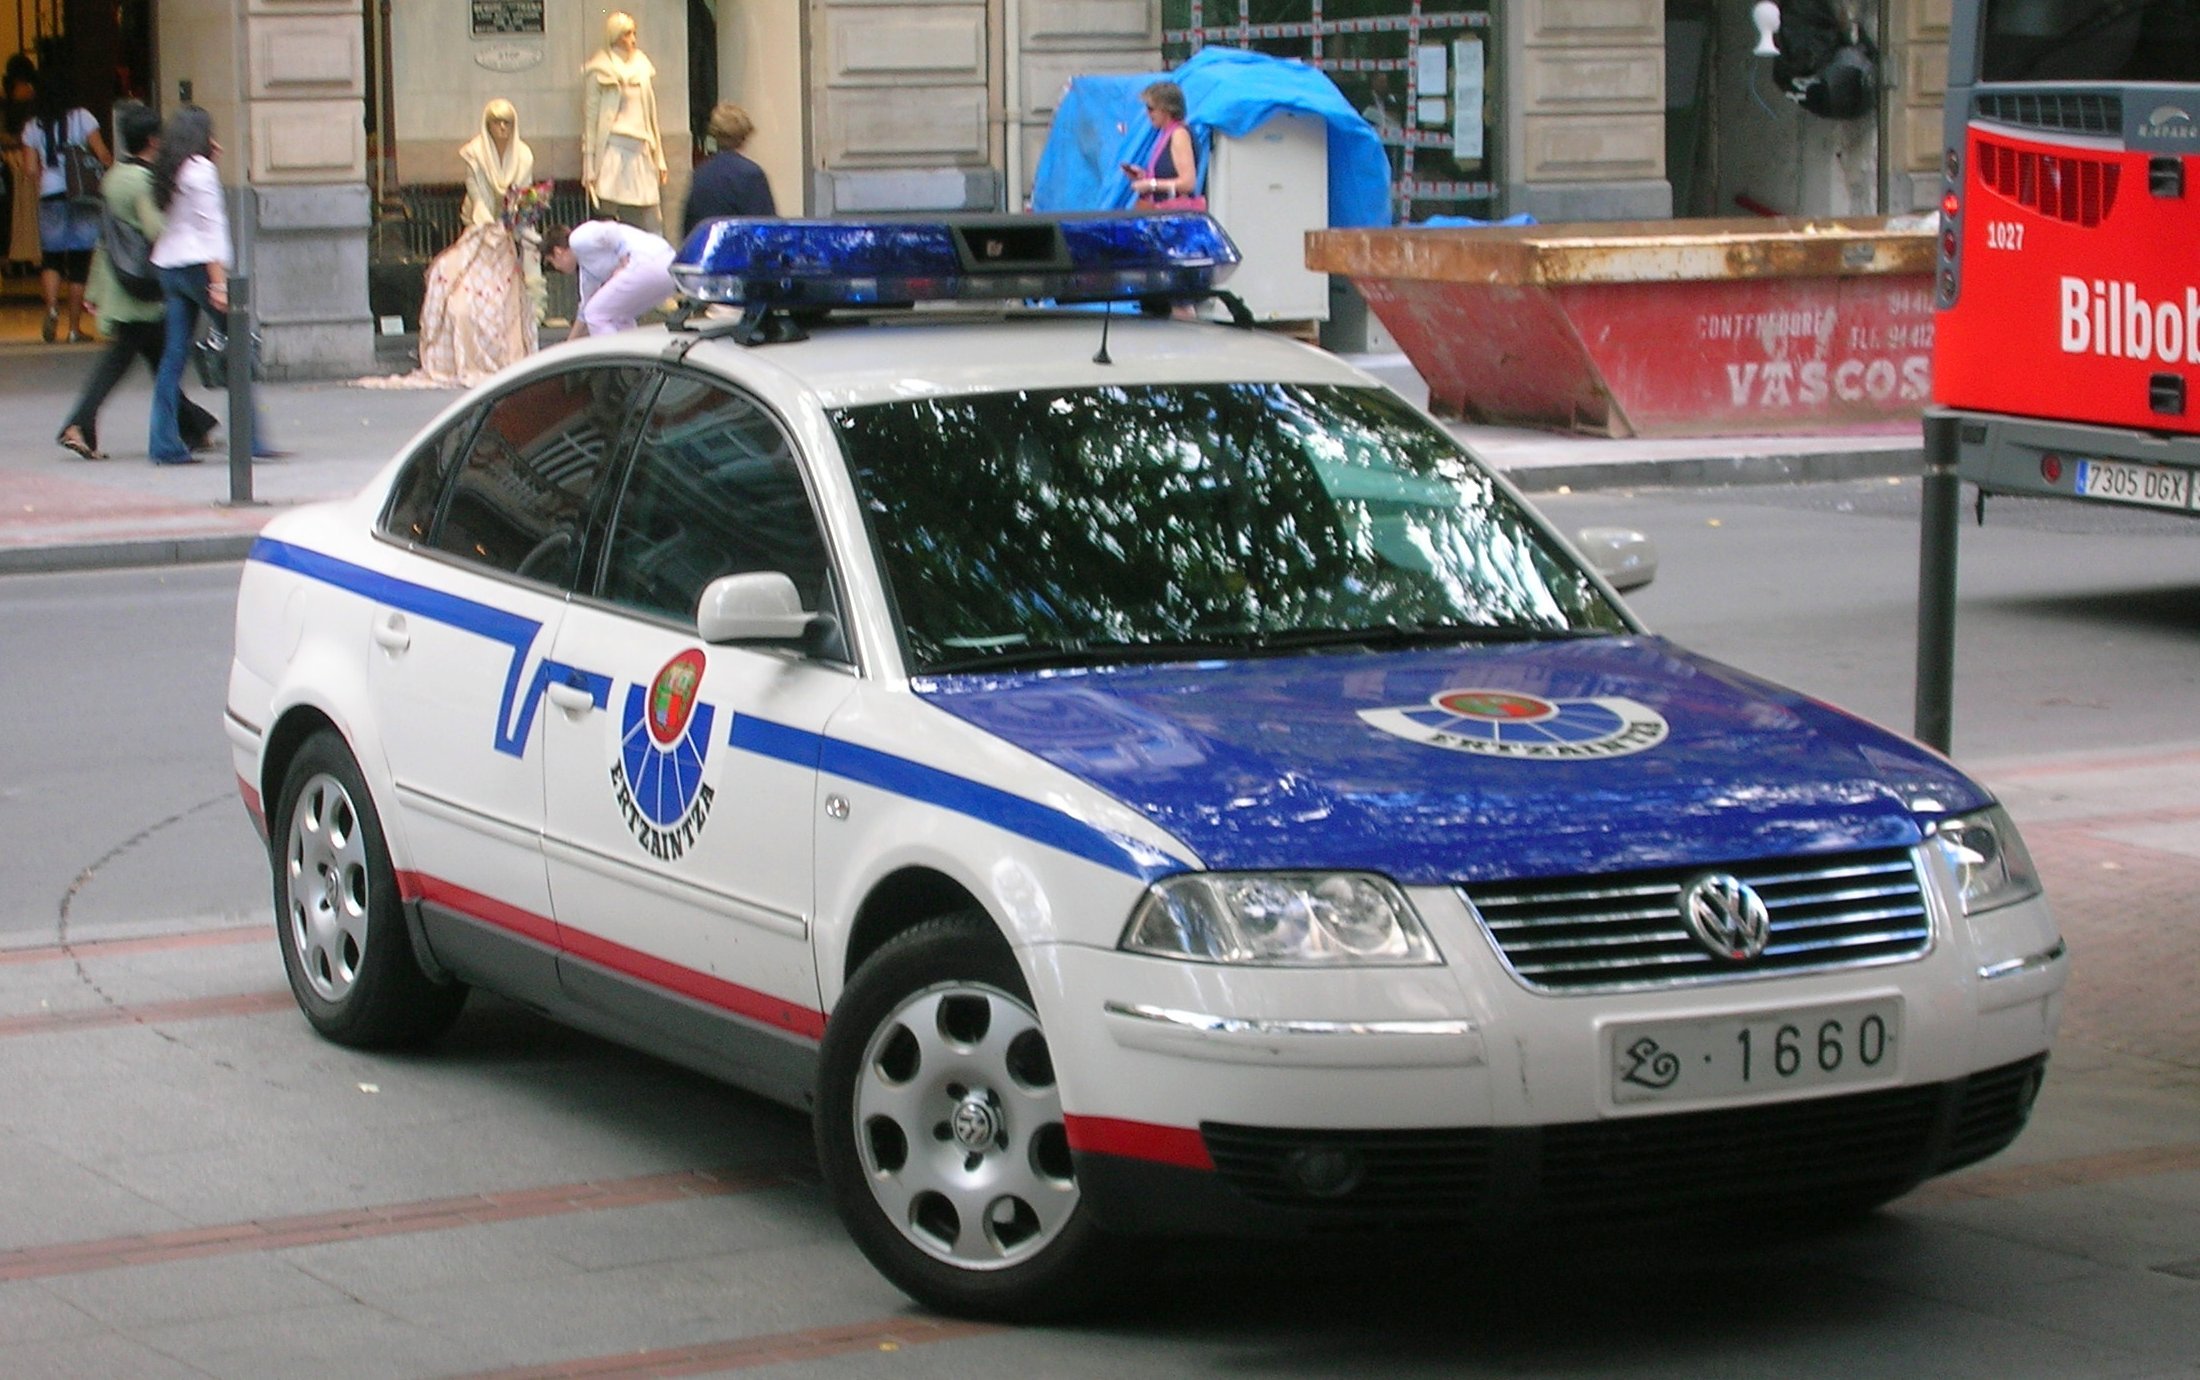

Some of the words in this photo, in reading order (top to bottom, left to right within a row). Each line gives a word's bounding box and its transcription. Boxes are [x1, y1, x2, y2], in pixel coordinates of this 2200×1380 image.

[1986, 220, 2025, 251] 1027
[1726, 355, 1931, 407] VASCOS
[2089, 464, 2138, 496] 7305
[2143, 470, 2182, 503] DGX
[609, 757, 715, 863] ERTZAINTZA
[1736, 1013, 1886, 1082] 1660
